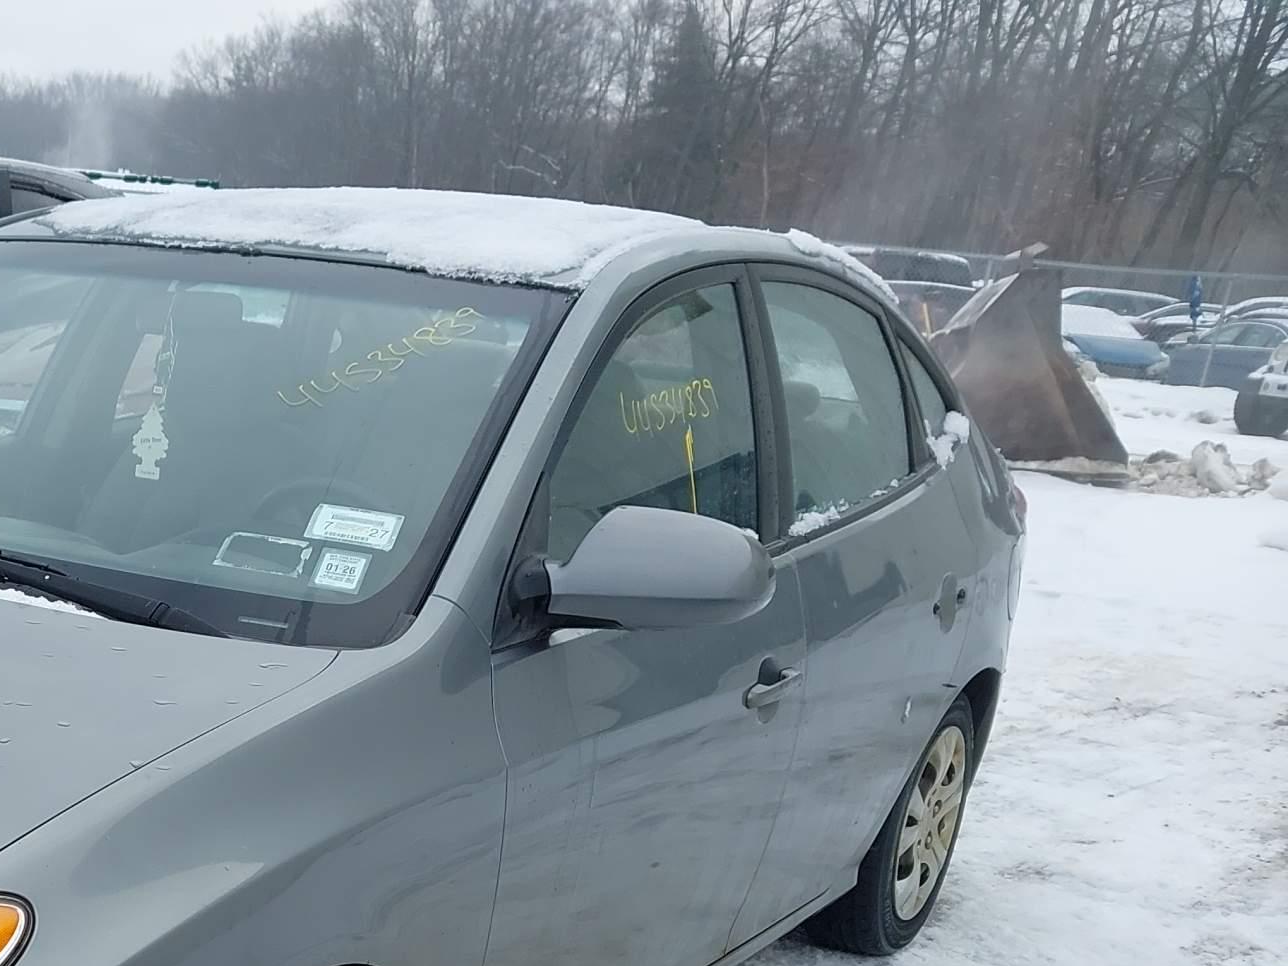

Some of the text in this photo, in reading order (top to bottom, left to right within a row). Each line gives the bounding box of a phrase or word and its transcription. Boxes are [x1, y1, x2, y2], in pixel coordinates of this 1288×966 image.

[277, 307, 486, 408] 44534839
[619, 378, 719, 442] 44534839
[368, 528, 390, 540] 27
